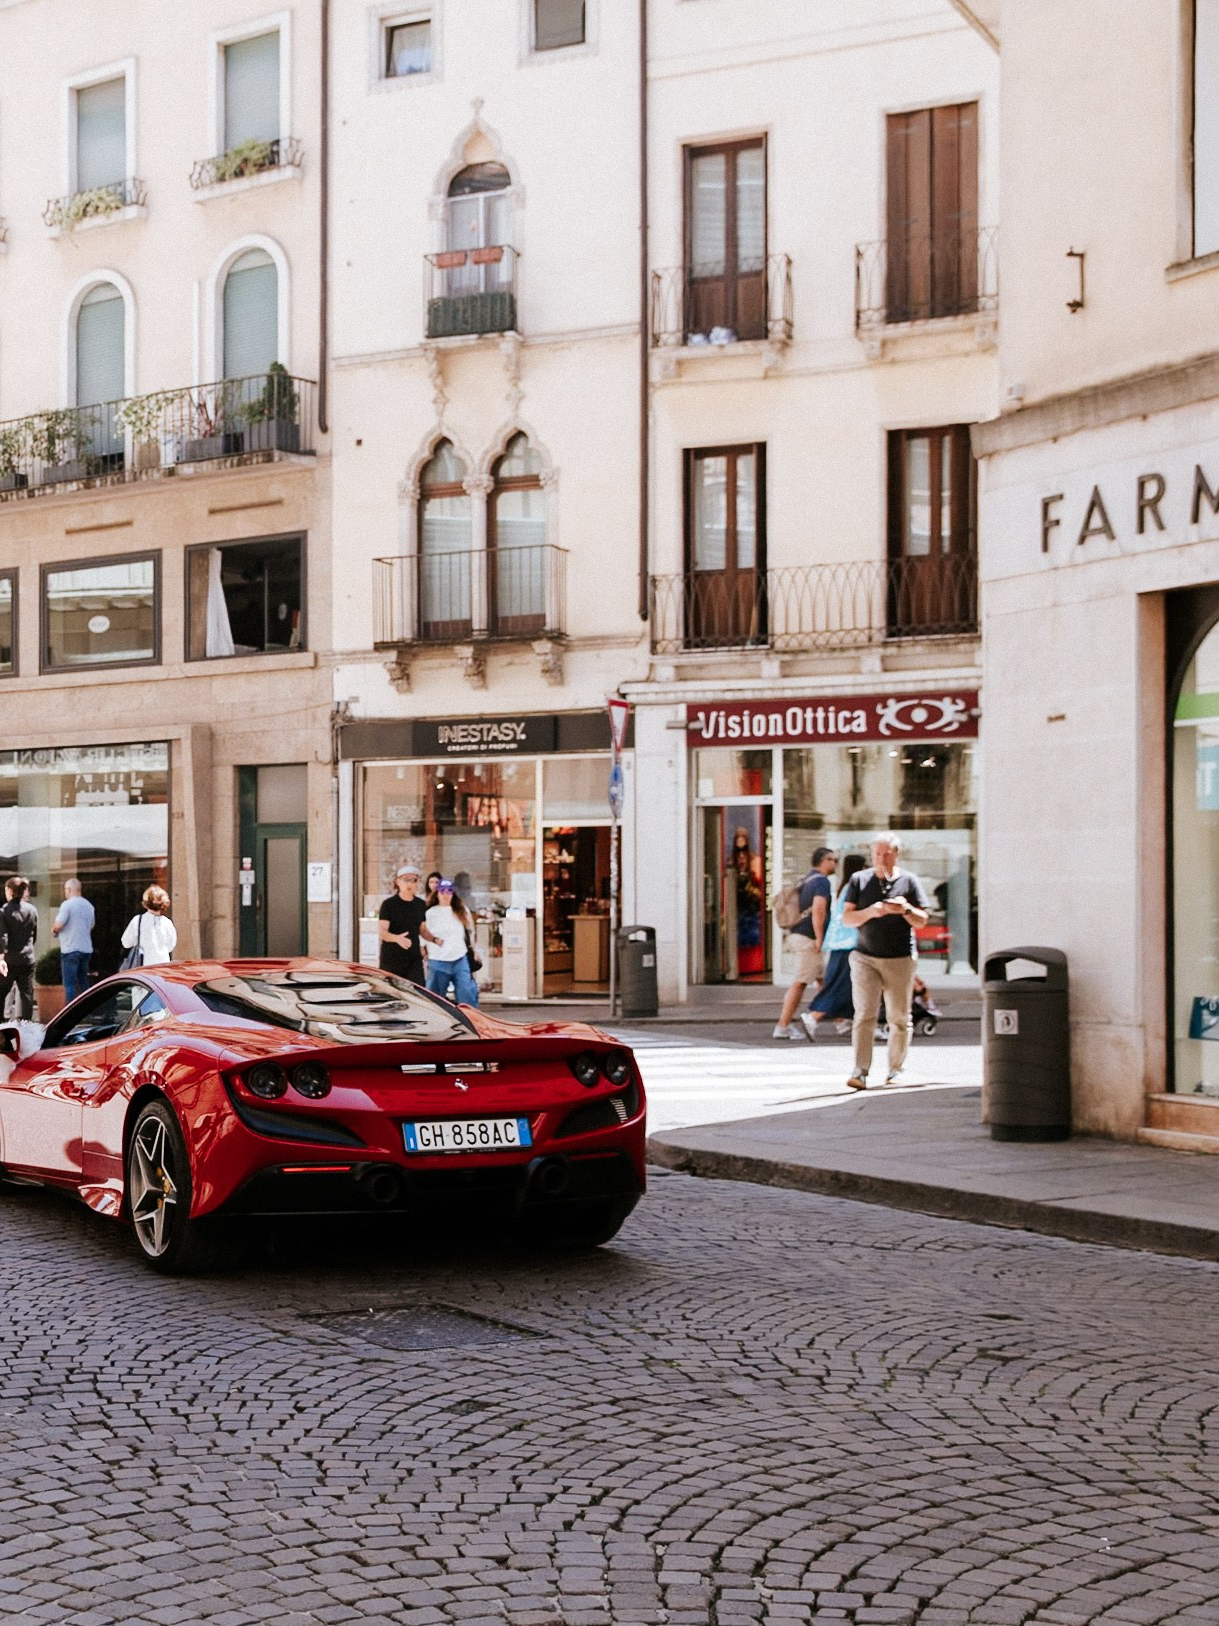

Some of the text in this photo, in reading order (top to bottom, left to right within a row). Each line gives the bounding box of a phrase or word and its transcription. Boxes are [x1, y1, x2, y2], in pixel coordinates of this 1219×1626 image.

[1041, 464, 1219, 553] FARM
[697, 706, 868, 739] VisionOttica
[312, 866, 323, 876] 27
[419, 1124, 445, 1147] GH
[452, 1121, 516, 1146] 858AC
